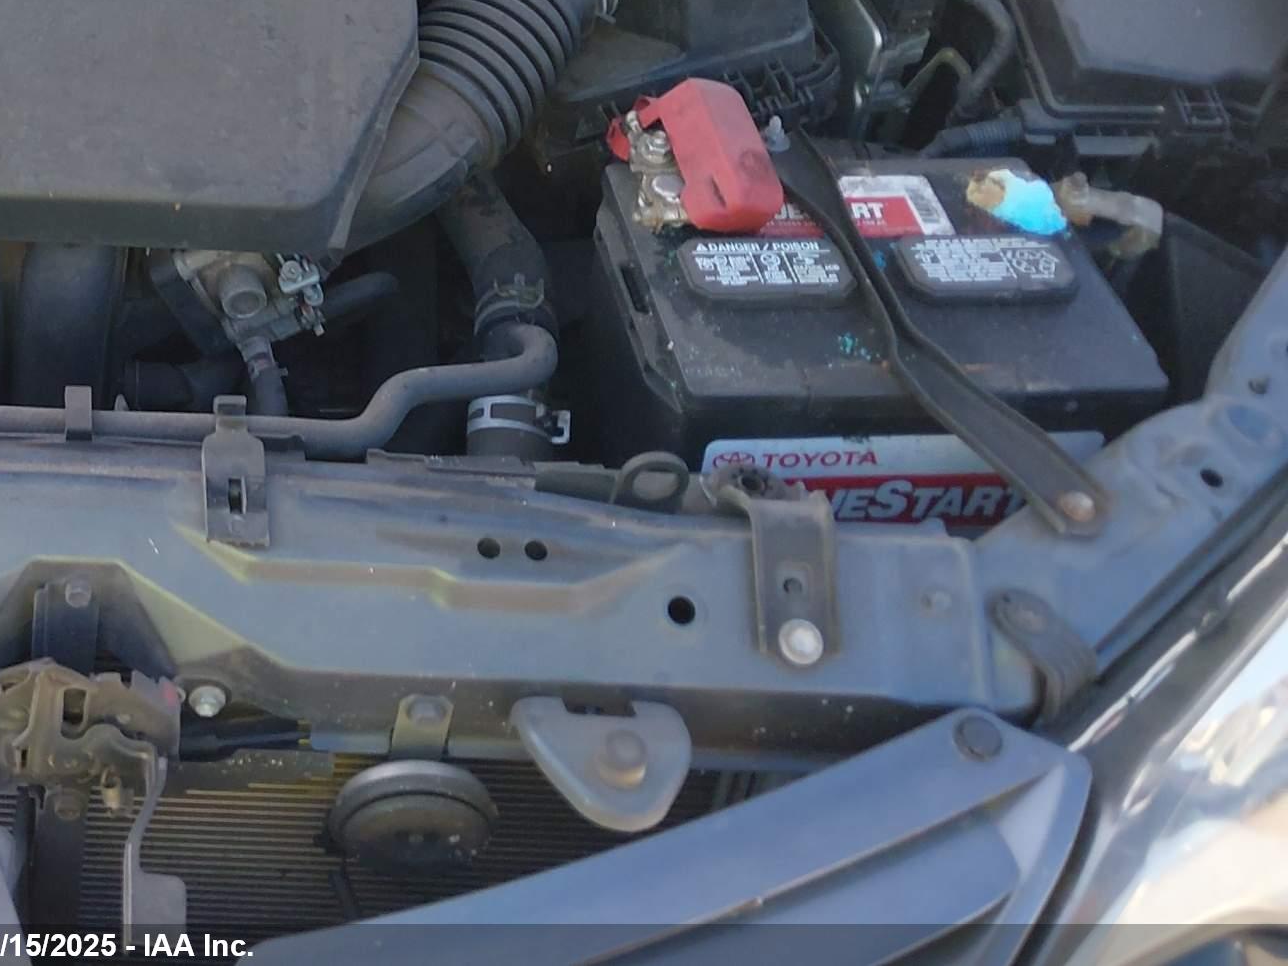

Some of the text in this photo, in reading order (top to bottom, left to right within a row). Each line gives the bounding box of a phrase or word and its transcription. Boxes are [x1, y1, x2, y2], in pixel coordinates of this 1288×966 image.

[708, 241, 761, 252] DANGER
[772, 241, 820, 252] POISON
[762, 450, 879, 469] TOYOTA
